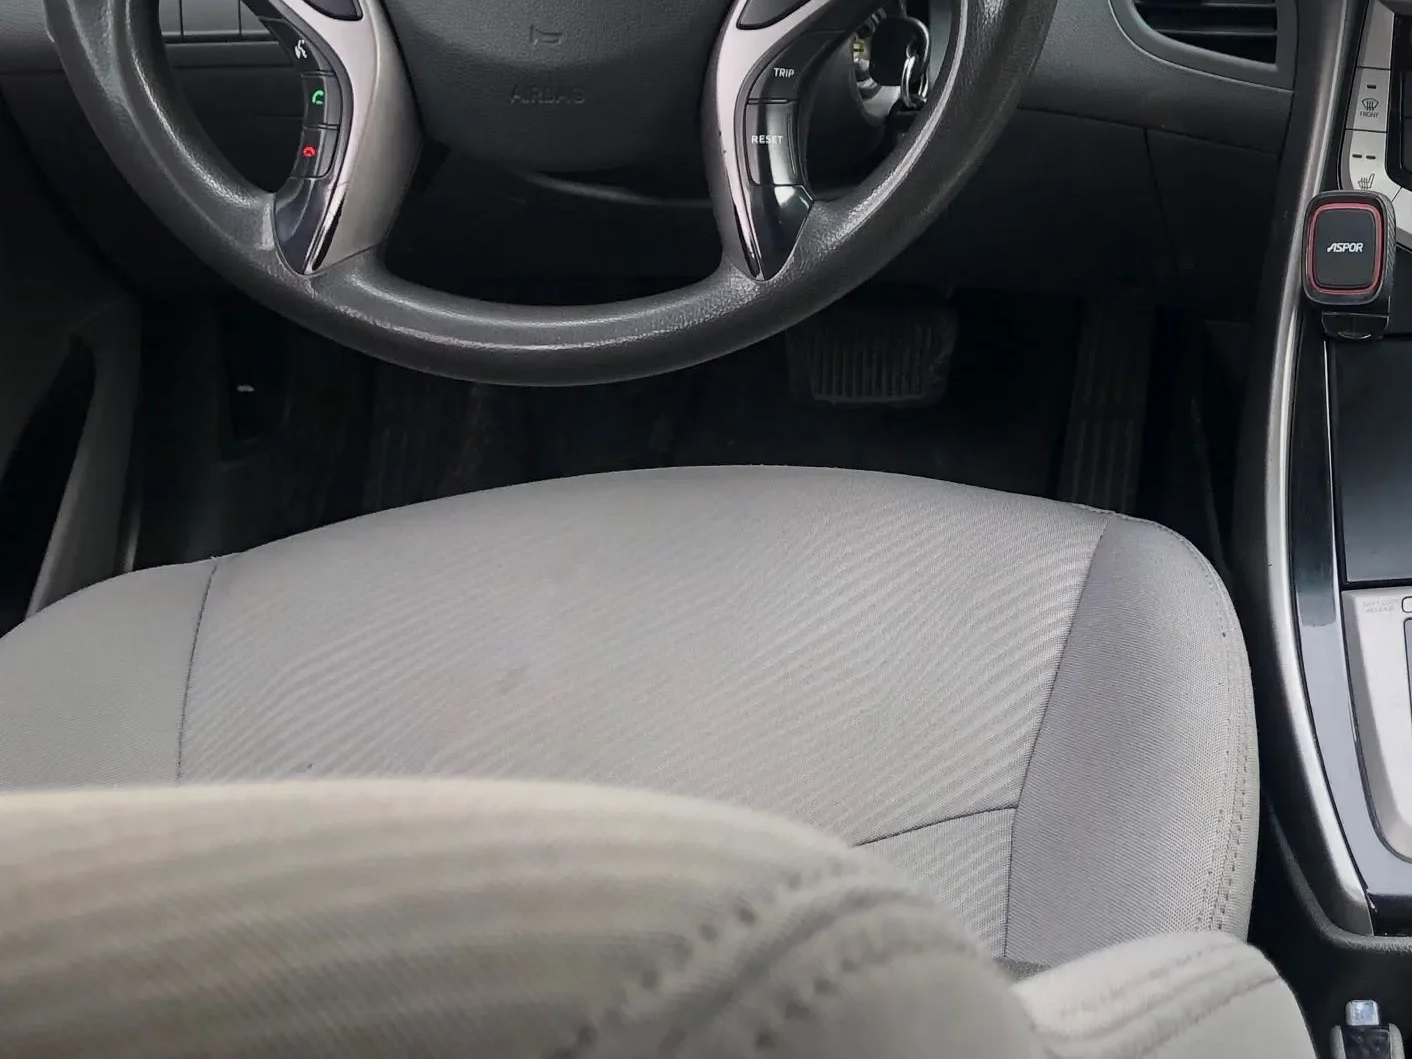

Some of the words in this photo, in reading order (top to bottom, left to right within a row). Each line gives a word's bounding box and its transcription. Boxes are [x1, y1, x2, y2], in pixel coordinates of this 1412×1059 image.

[773, 67, 795, 78] TRIP
[1359, 110, 1379, 119] FRONT
[751, 134, 784, 146] RESET
[1327, 242, 1364, 254] ASPOR
